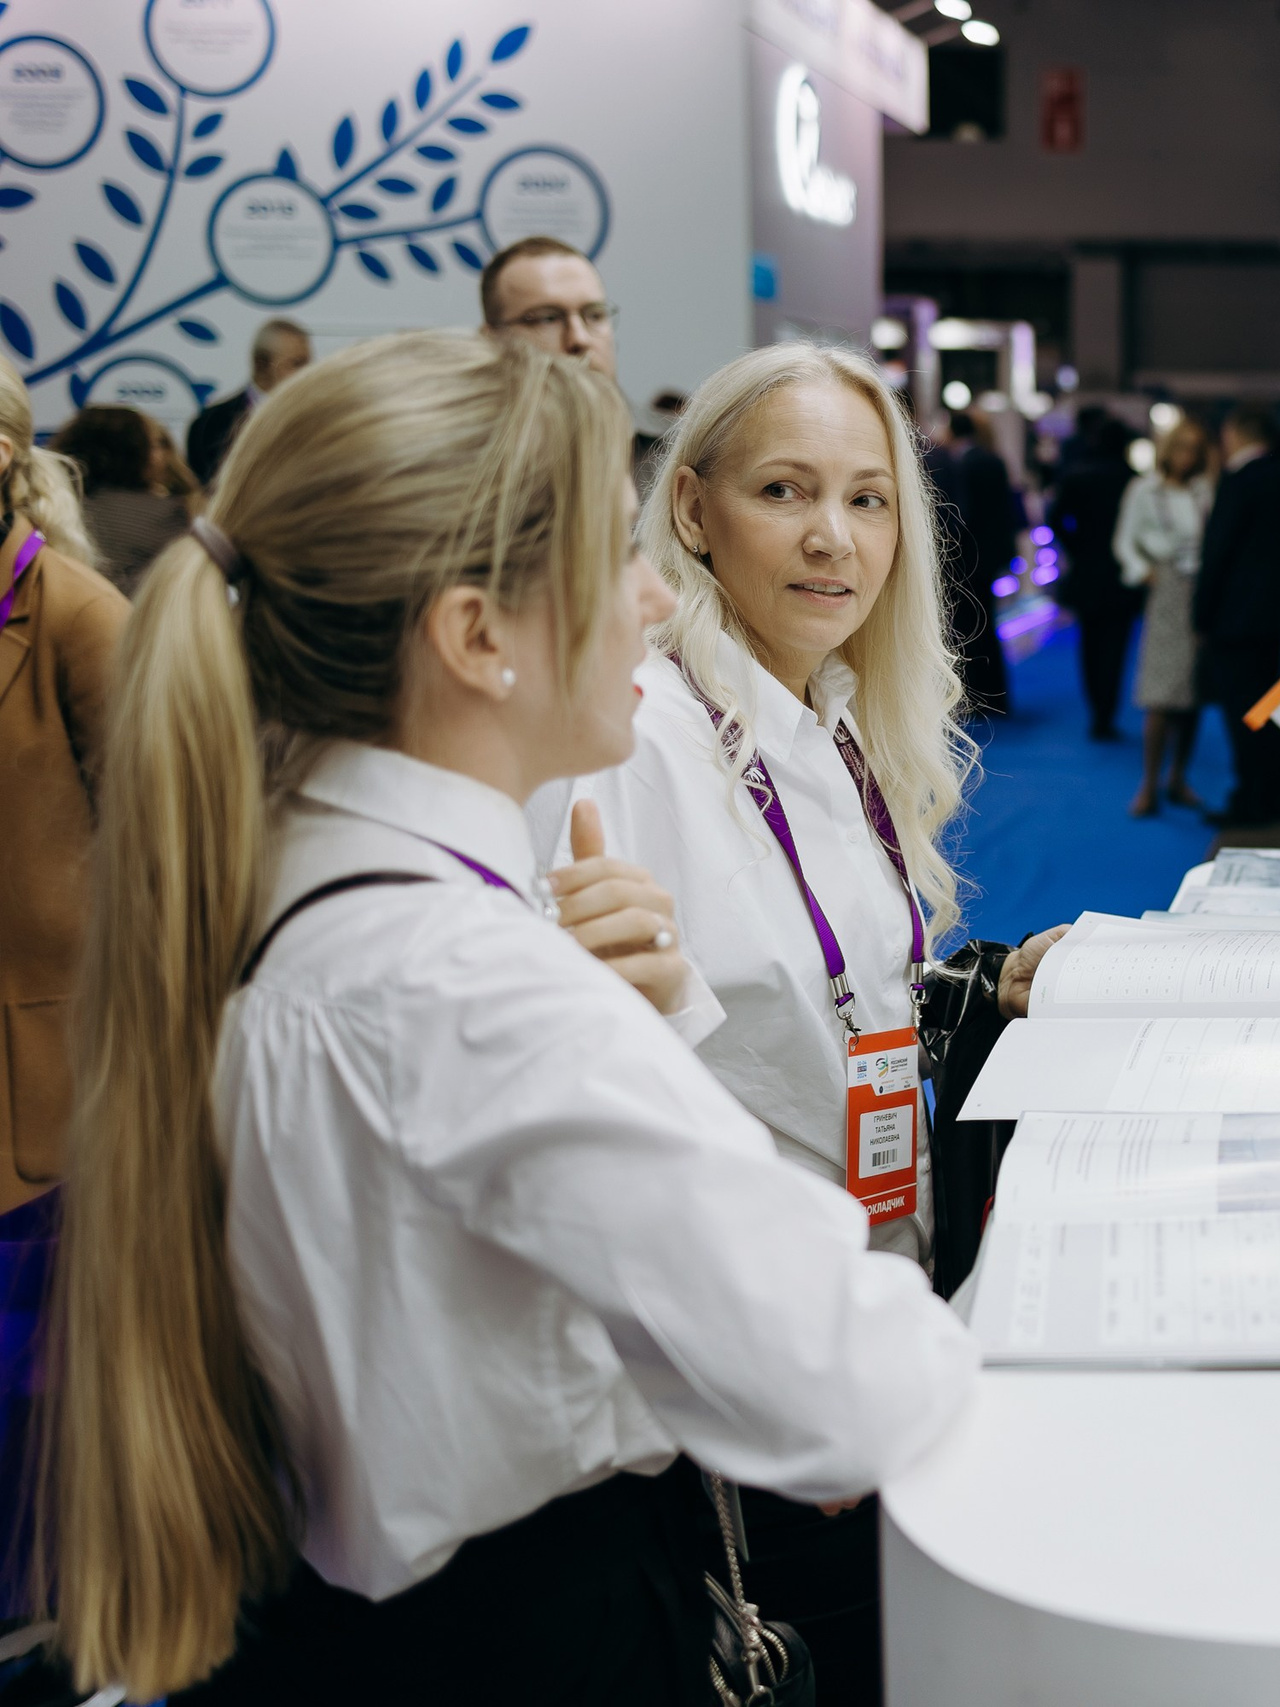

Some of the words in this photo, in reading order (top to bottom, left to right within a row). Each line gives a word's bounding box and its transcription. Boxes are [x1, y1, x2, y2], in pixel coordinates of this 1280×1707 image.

[873, 1113, 898, 1123] ГРИНЕВИЧ
[875, 1123, 896, 1134] ТАТЬЯНА
[869, 1134, 900, 1146] НИКОЛАЕВНА
